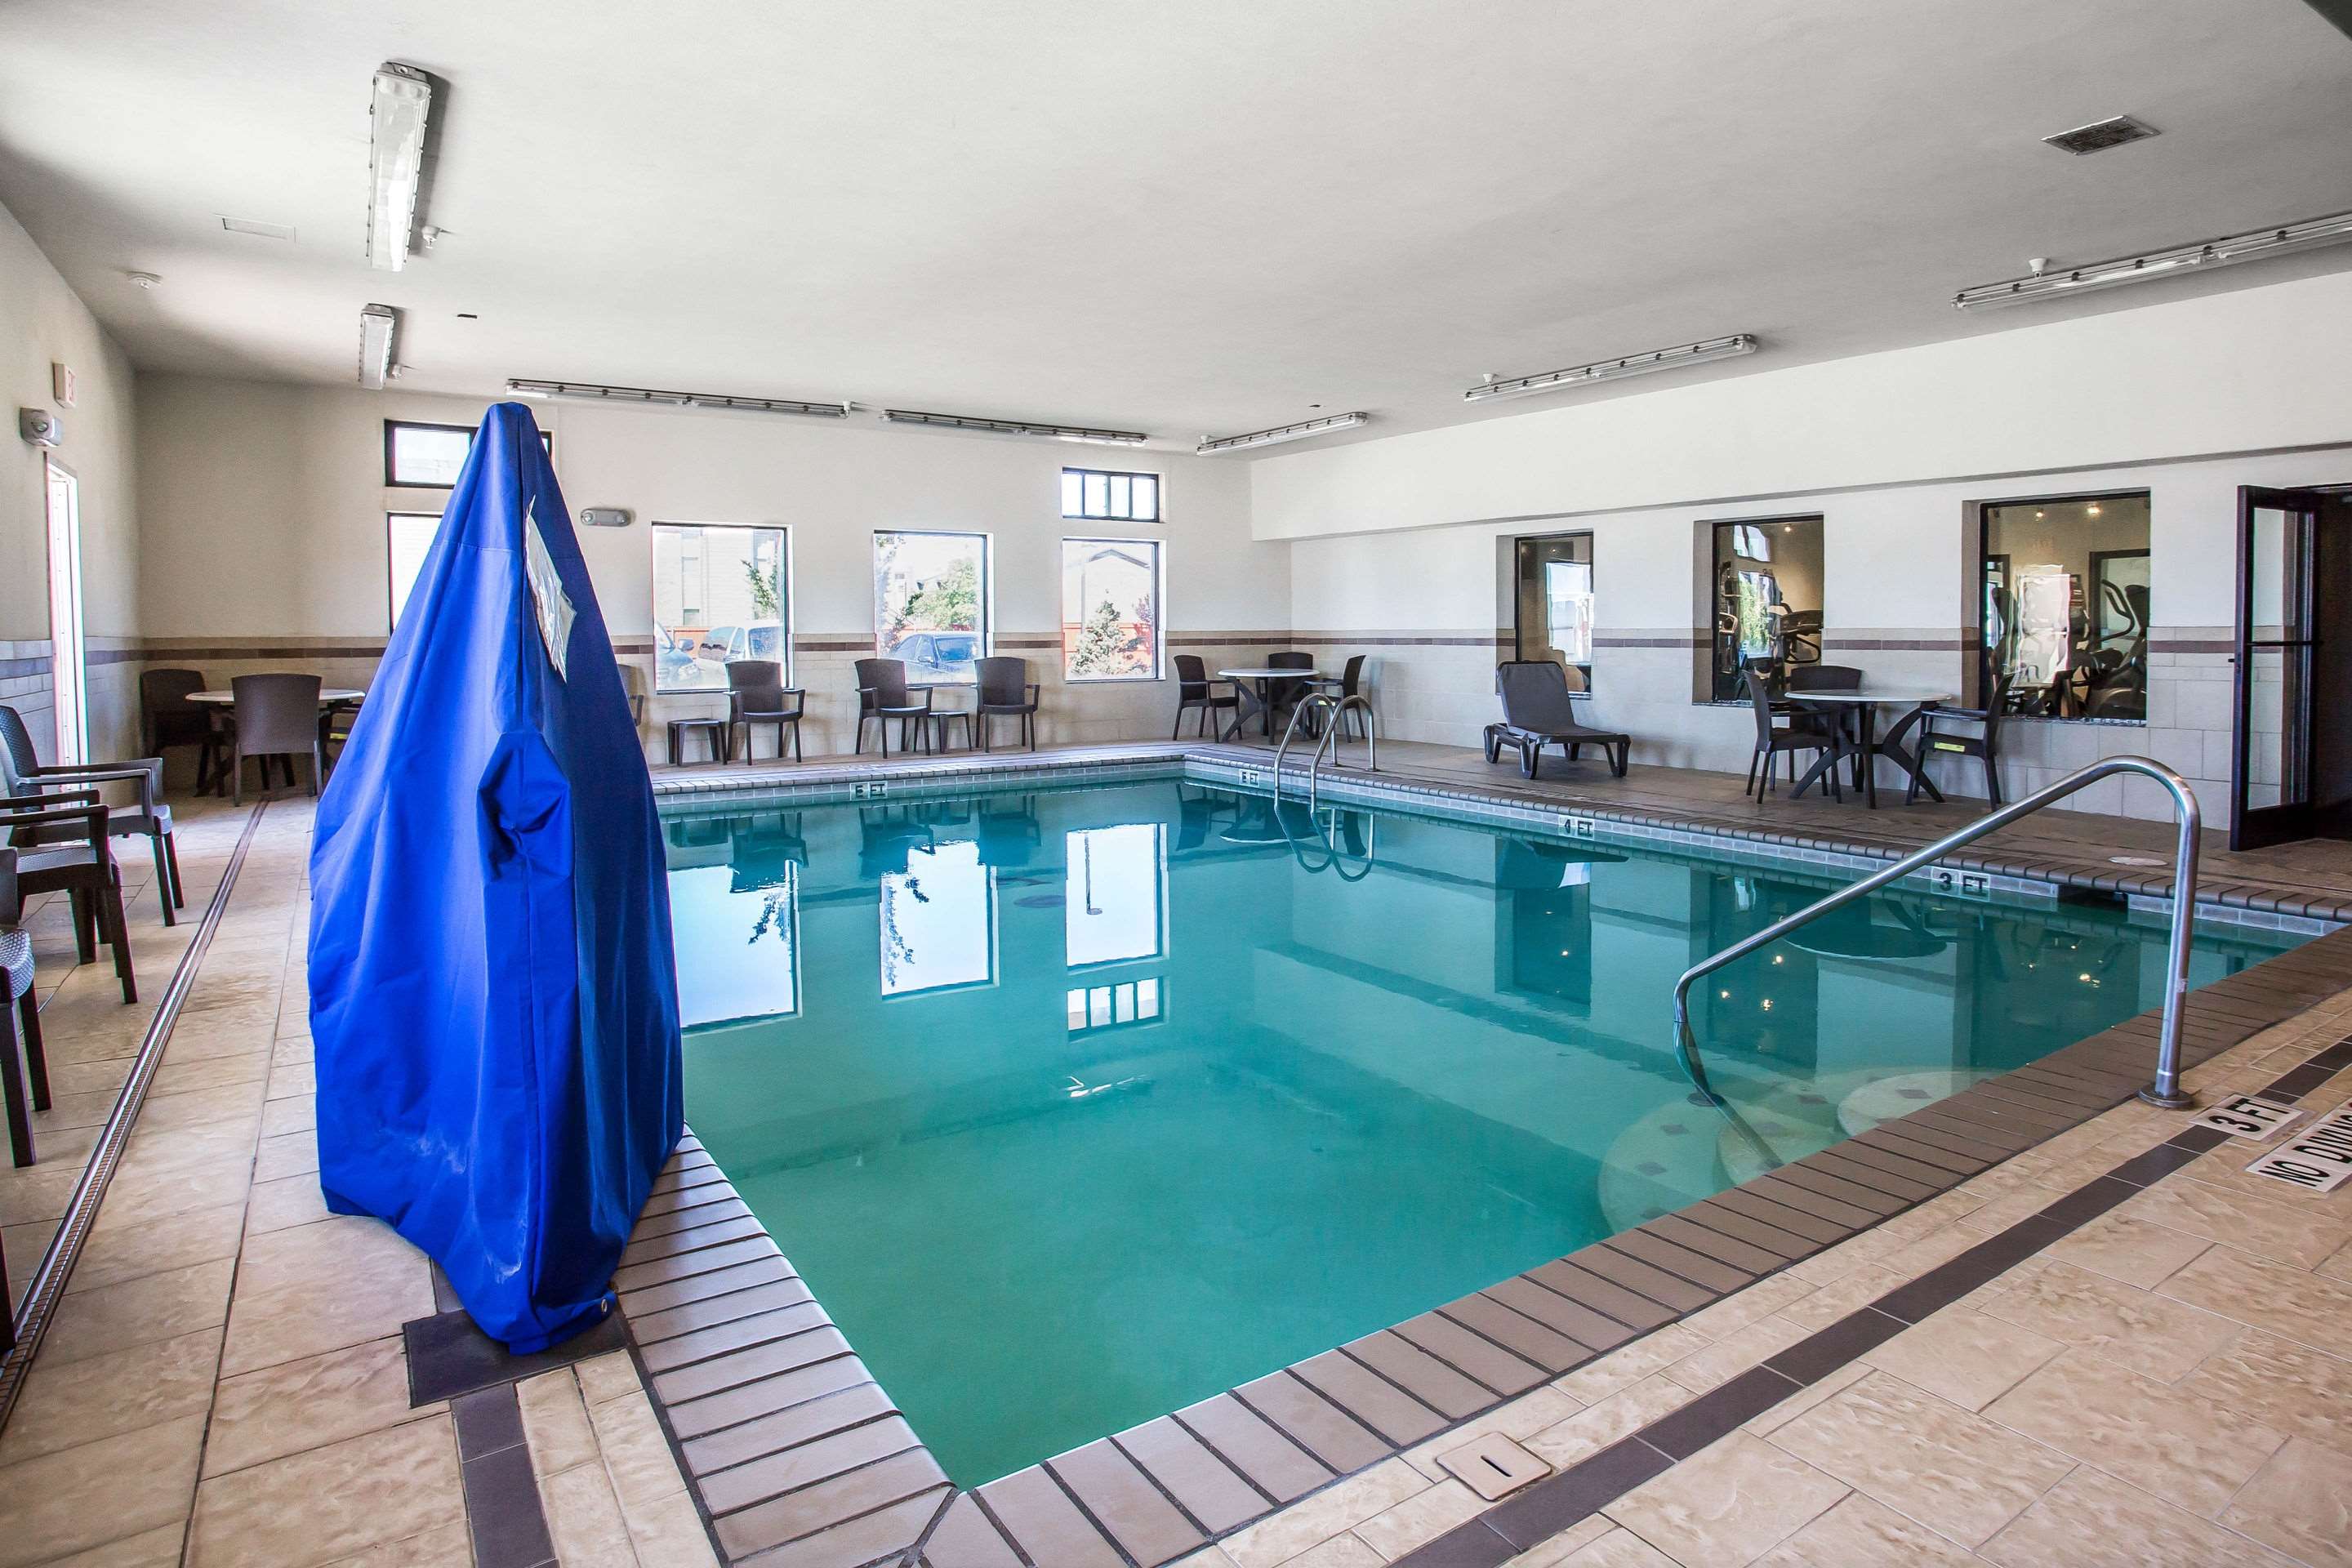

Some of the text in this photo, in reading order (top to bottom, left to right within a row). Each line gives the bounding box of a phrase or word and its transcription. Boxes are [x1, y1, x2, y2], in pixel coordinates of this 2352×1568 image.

[1962, 875, 1988, 889] FT
[2207, 1097, 2290, 1132] 3 FT
[2257, 1160, 2331, 1187] NO
